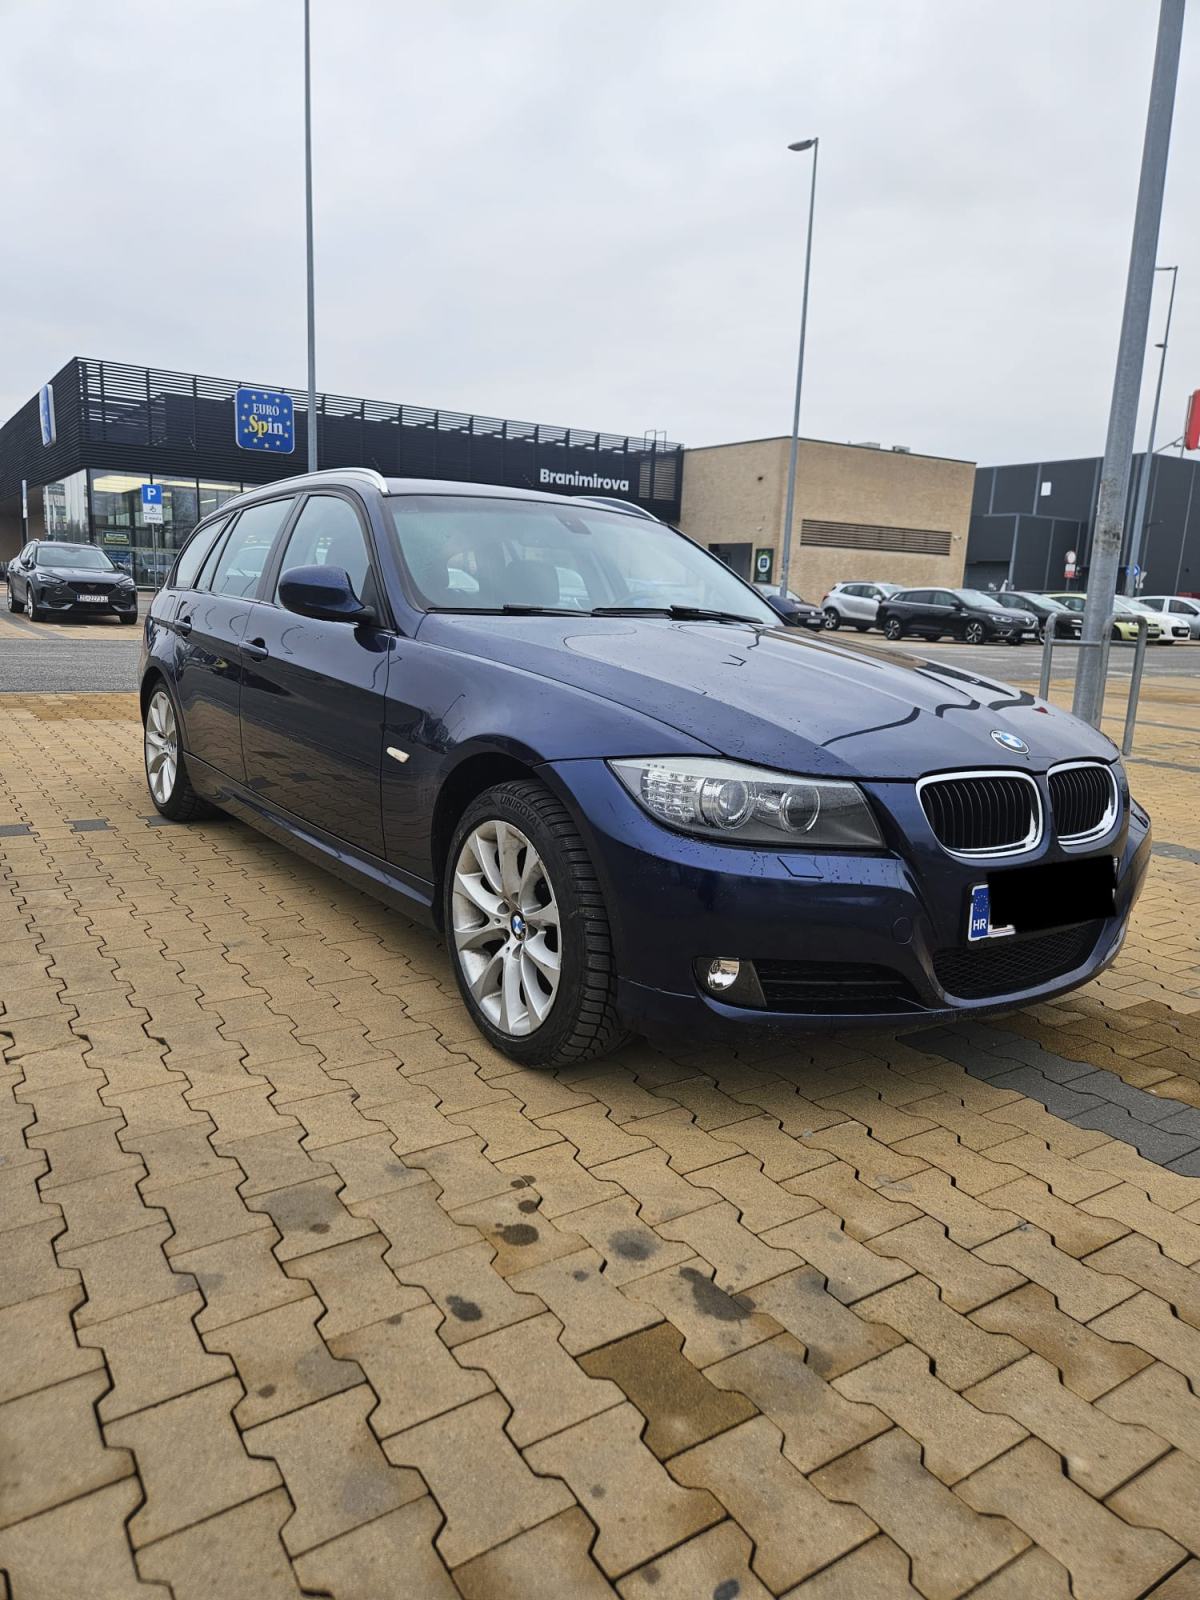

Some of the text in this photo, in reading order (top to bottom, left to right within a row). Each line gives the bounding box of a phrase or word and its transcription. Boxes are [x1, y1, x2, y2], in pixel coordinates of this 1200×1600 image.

[253, 403, 280, 416] EURO
[249, 414, 283, 438] Spin
[539, 468, 629, 491] Branimirova
[147, 487, 157, 500] P
[973, 918, 987, 931] HR
